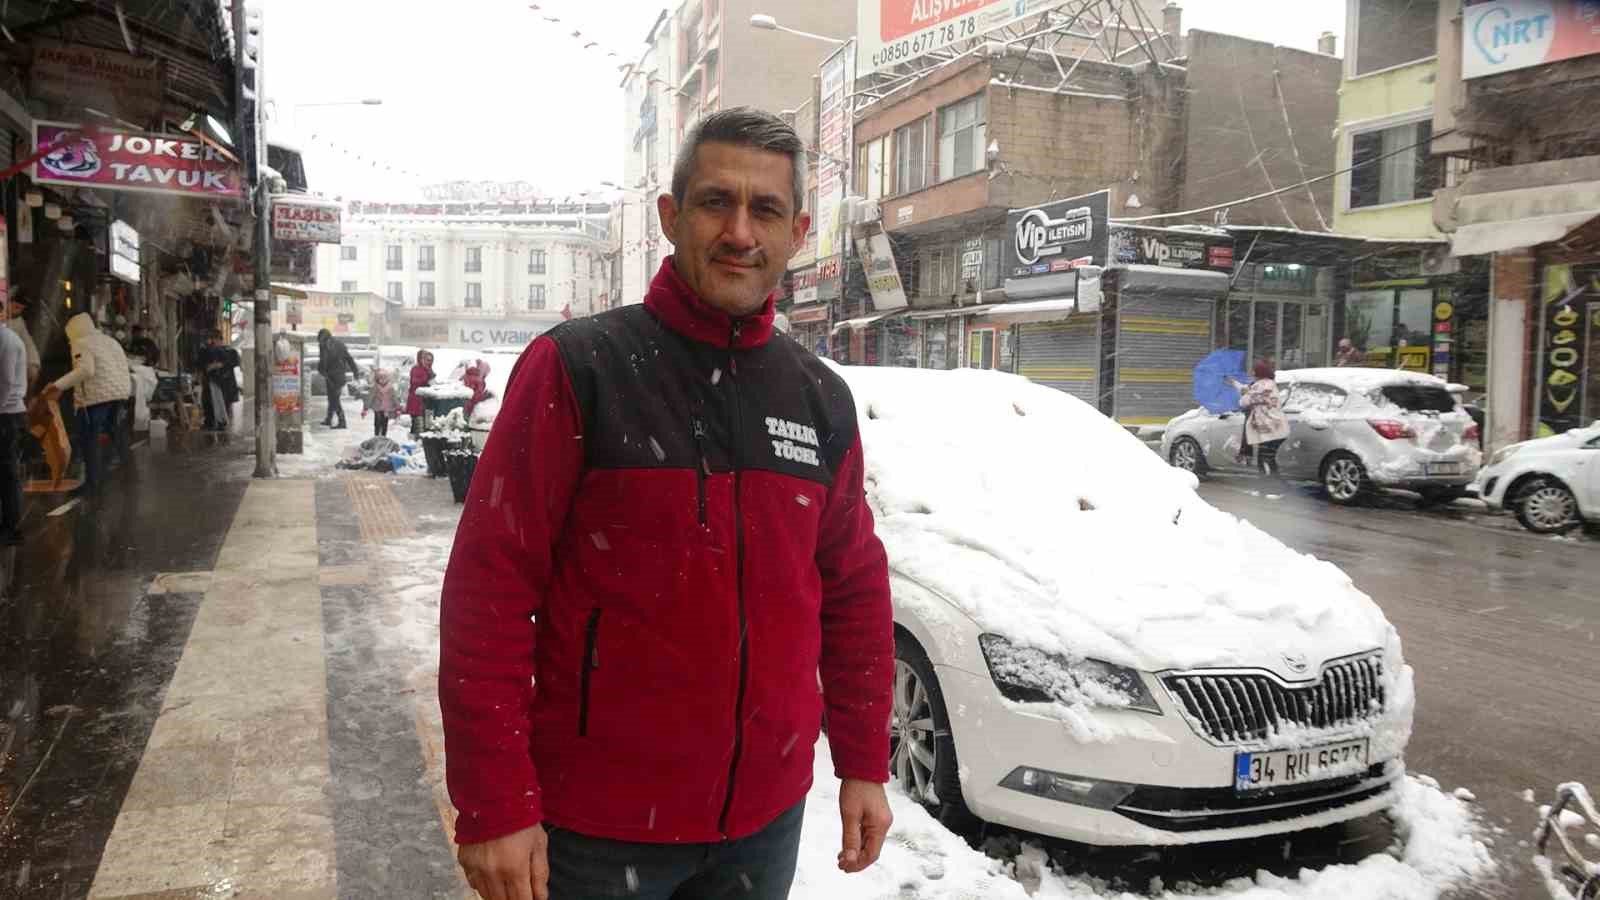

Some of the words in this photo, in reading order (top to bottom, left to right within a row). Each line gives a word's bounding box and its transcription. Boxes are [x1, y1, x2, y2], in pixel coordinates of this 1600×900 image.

[880, 40, 909, 64] 0850
[913, 31, 935, 53] 677
[940, 24, 954, 44] 78
[960, 16, 975, 38] 78
[1493, 15, 1549, 48] NRT
[109, 134, 224, 162] JOKER
[108, 163, 226, 189] TAVUK
[1016, 221, 1047, 257] Vip
[1143, 238, 1170, 262] Vip
[460, 329, 483, 343] LC
[772, 439, 819, 467] YÜCEL
[1250, 757, 1275, 784] 34
